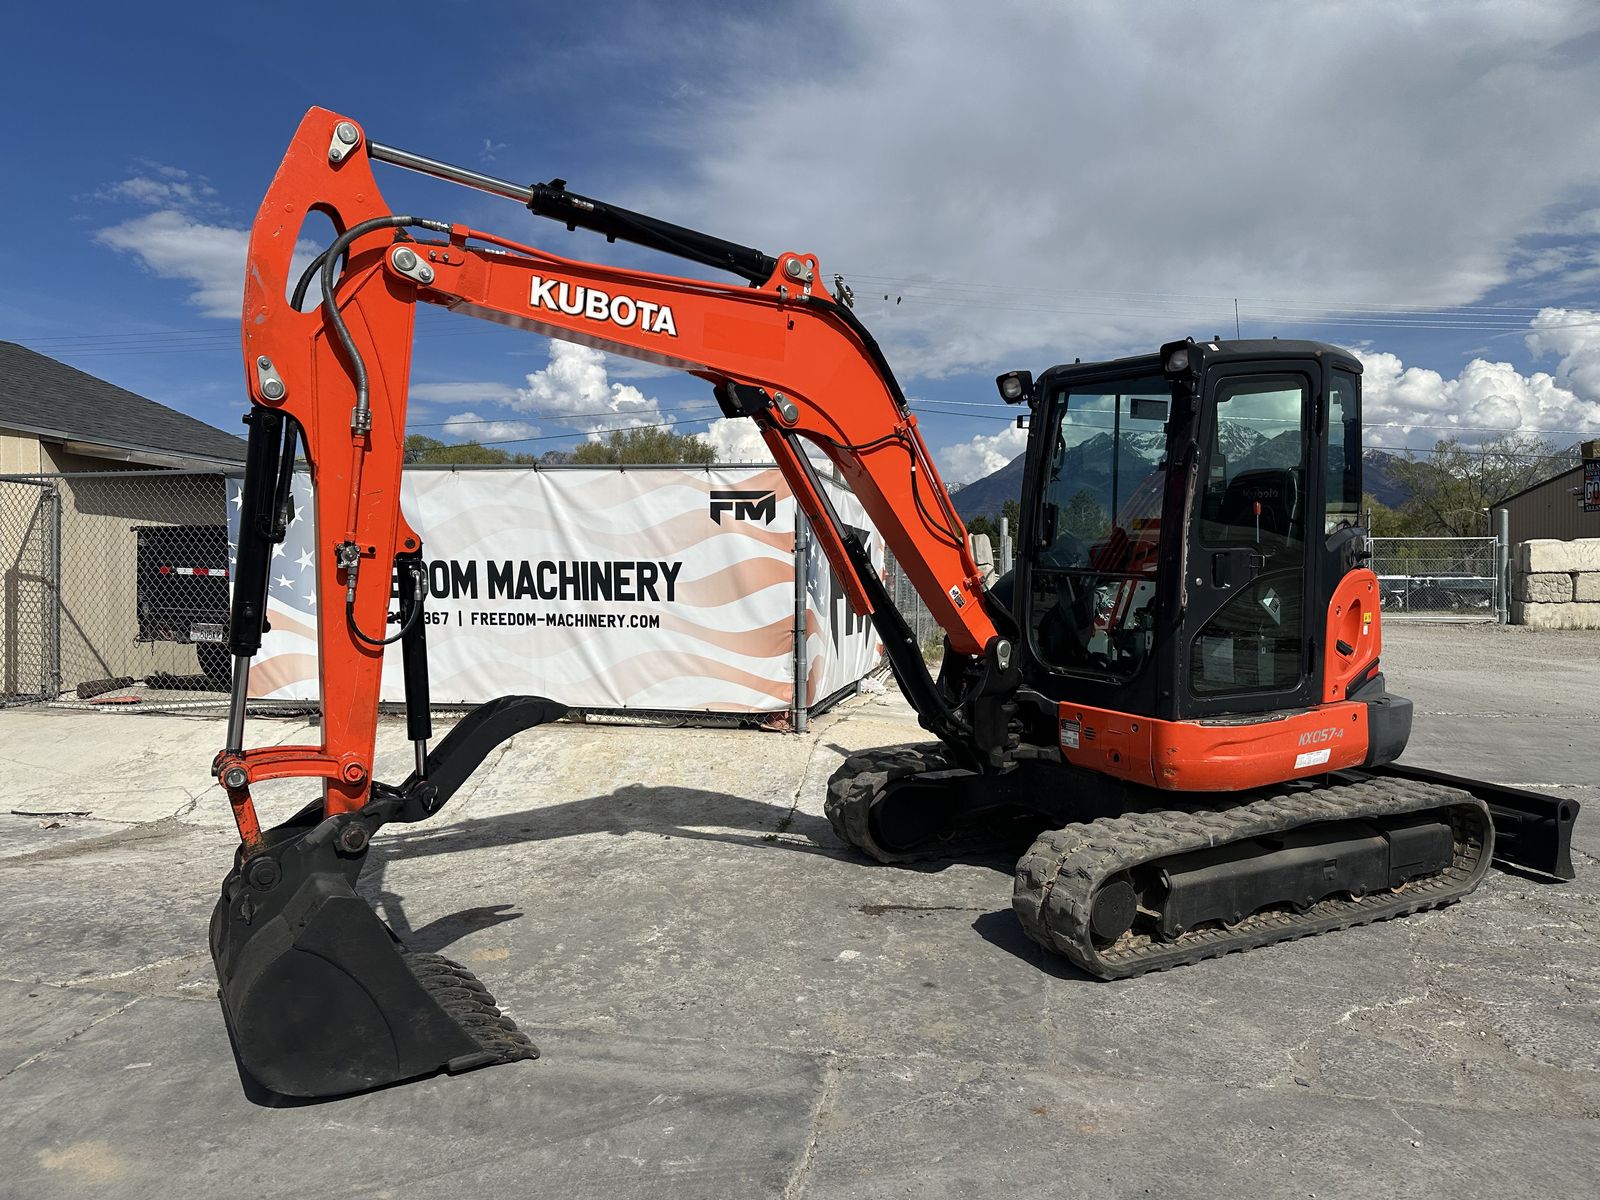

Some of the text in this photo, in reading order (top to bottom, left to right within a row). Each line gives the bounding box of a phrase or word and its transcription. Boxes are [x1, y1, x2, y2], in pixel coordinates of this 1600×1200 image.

[529, 275, 678, 337] KUBOTA
[710, 491, 776, 526] FM
[487, 560, 683, 602] MACHINERY
[471, 612, 660, 628] FREEDOM-MACHINERY.COM
